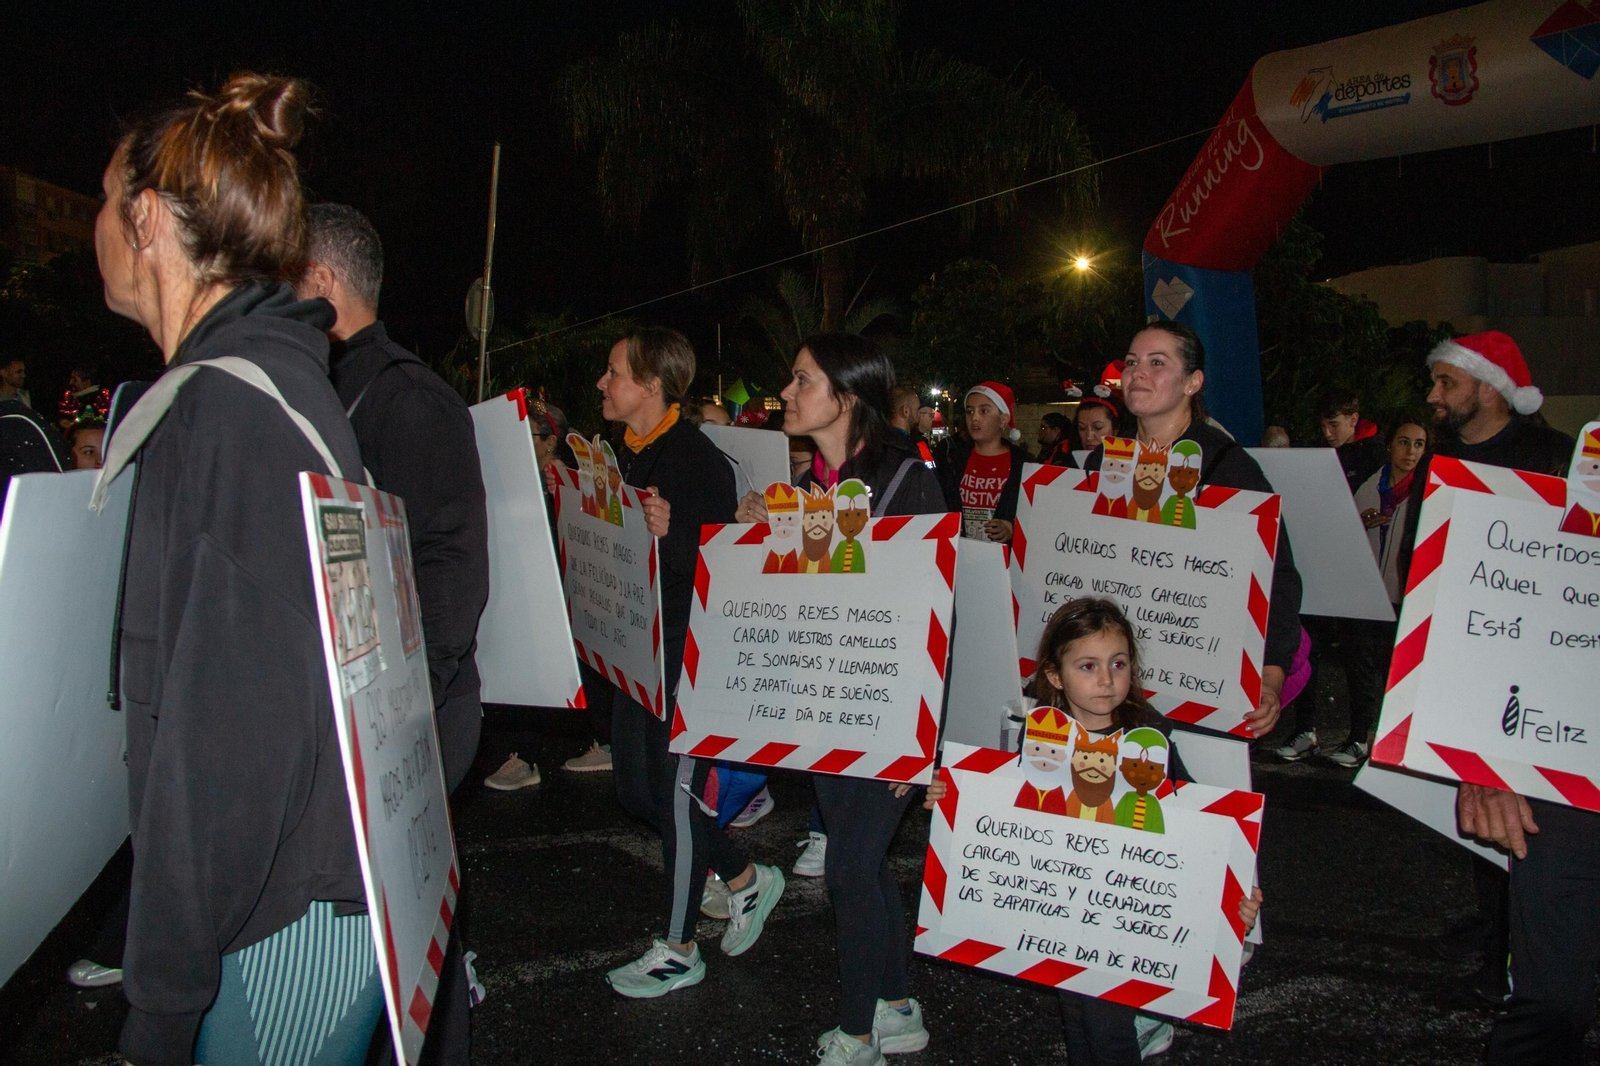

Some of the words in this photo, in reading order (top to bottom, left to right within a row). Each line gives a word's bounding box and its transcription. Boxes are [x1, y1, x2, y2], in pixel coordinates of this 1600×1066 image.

[1334, 74, 1411, 102] deportes
[1155, 117, 1265, 249] Running
[568, 523, 591, 547] QUERIDOS
[593, 531, 609, 555] REYES
[1055, 531, 1117, 559] QUERIDOS
[1131, 546, 1174, 569] REYES
[1184, 555, 1234, 579] MAGOS:
[580, 558, 588, 577] LA
[588, 562, 617, 591] FELICIDAD
[623, 580, 633, 600] LA
[632, 582, 645, 606] PAZ
[1045, 571, 1084, 590] CARGAD
[1091, 578, 1142, 599] VUESTROS
[1151, 587, 1208, 609] CAMELLOS
[1562, 586, 1600, 608] Que
[572, 578, 586, 599] SEAN
[589, 587, 612, 614] REGALOS
[615, 602, 626, 620] QUE
[629, 609, 648, 631] DUREN
[722, 598, 787, 621] QUERIDOS
[798, 604, 840, 621] REYES
[1043, 590, 1059, 605] DE
[1122, 603, 1129, 618] Y
[1136, 606, 1201, 630] LLENADNOS
[583, 609, 598, 632] TODO
[600, 620, 609, 639] EL
[613, 627, 627, 649] AÑO
[733, 626, 779, 644] CARGAD
[788, 630, 833, 646] VUESTROS
[839, 634, 897, 650] CAMELLOS
[1137, 625, 1152, 640] DE
[1467, 609, 1523, 640] Está
[737, 651, 756, 667] DE
[761, 651, 822, 671] SONRISAS
[828, 657, 836, 673] Y
[838, 659, 899, 678] LLENADNOS
[1158, 668, 1174, 686] DE
[1179, 675, 1225, 699] REYES!
[726, 676, 747, 692] LAS
[752, 677, 818, 698] ZAPATILLAS
[822, 685, 835, 699] DE
[840, 684, 893, 704] SUEÑOS.
[795, 707, 813, 721] DÍA
[818, 711, 832, 723] DE
[839, 712, 881, 737] REYES!
[976, 815, 1054, 846] QUERIDOS
[1065, 832, 1110, 856] REYES
[1120, 843, 1185, 871] MAGOS:
[963, 843, 1020, 866] CARGAD
[1030, 854, 1093, 881] VUESTROS
[1105, 869, 1178, 899] CAMELLOS
[959, 885, 983, 903] LAS
[993, 892, 1070, 919] ZAPATILLAS
[1080, 908, 1102, 926] DE
[961, 864, 980, 881] DE
[987, 870, 1058, 898] SONRISAS
[1068, 885, 1077, 900] Y
[1088, 889, 1172, 919] LLENADNOS
[1017, 929, 1067, 957] ¡FELIZ
[1106, 949, 1126, 968] DE
[1131, 955, 1178, 984] REYES!
